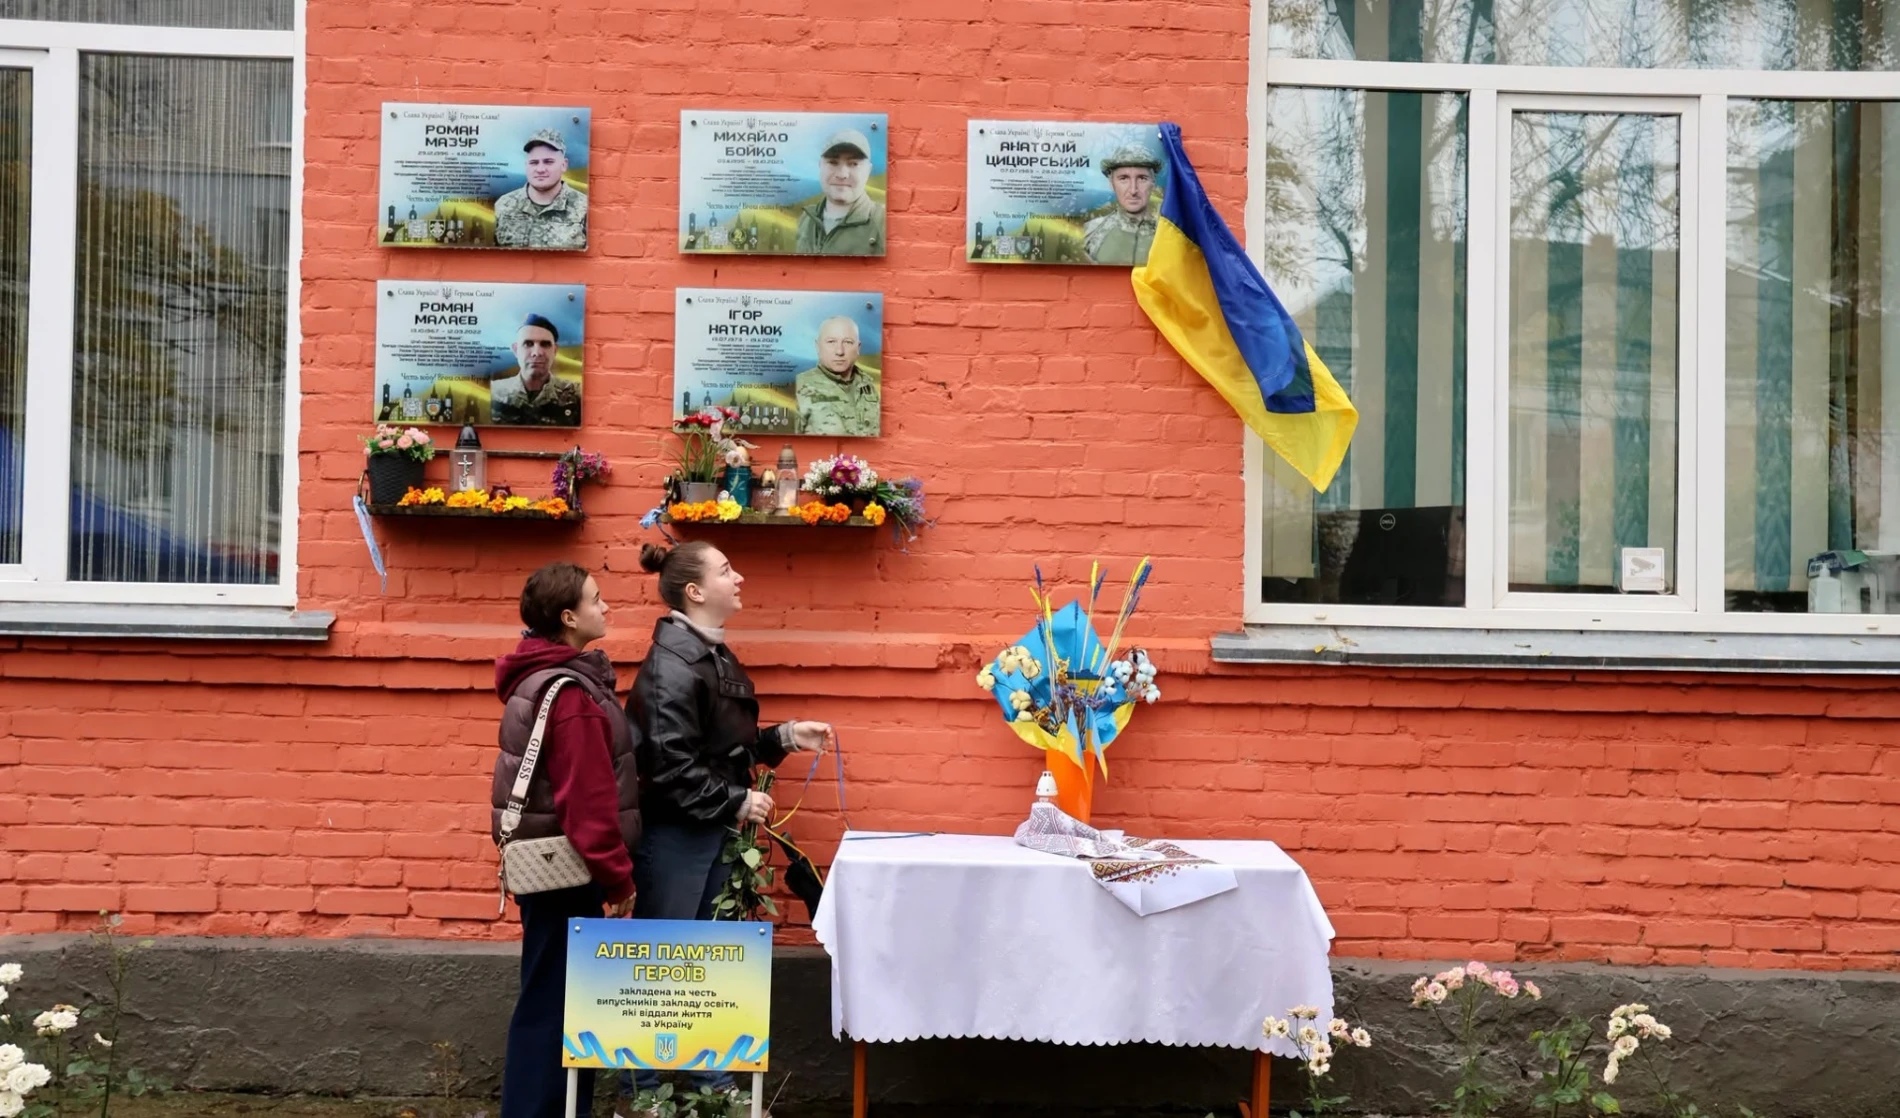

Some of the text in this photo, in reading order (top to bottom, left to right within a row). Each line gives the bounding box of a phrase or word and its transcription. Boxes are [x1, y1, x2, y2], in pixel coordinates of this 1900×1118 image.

[425, 125, 480, 136] РОМАН
[714, 129, 788, 143] МИХАЙЛО
[425, 137, 478, 148] МАЗУР
[1000, 140, 1077, 153] АНАТОЛІЙ
[725, 144, 776, 157] БОЙКО
[986, 155, 1090, 168] ЦИЦЮРСЬКИЙ
[420, 302, 474, 313] РОМАН
[729, 309, 763, 320] ІГОР
[709, 325, 782, 336] НАТАЛЮК
[539, 682, 560, 720] GUESS
[519, 738, 540, 781] GUESS
[595, 942, 650, 959] АЛЕЯ
[633, 963, 706, 982] ГЕРОЇВ
[619, 987, 672, 997] закладена
[596, 998, 738, 1010] випускників закладу освіти,
[640, 1010, 679, 1019] віддали
[654, 1019, 693, 1030] Україну
